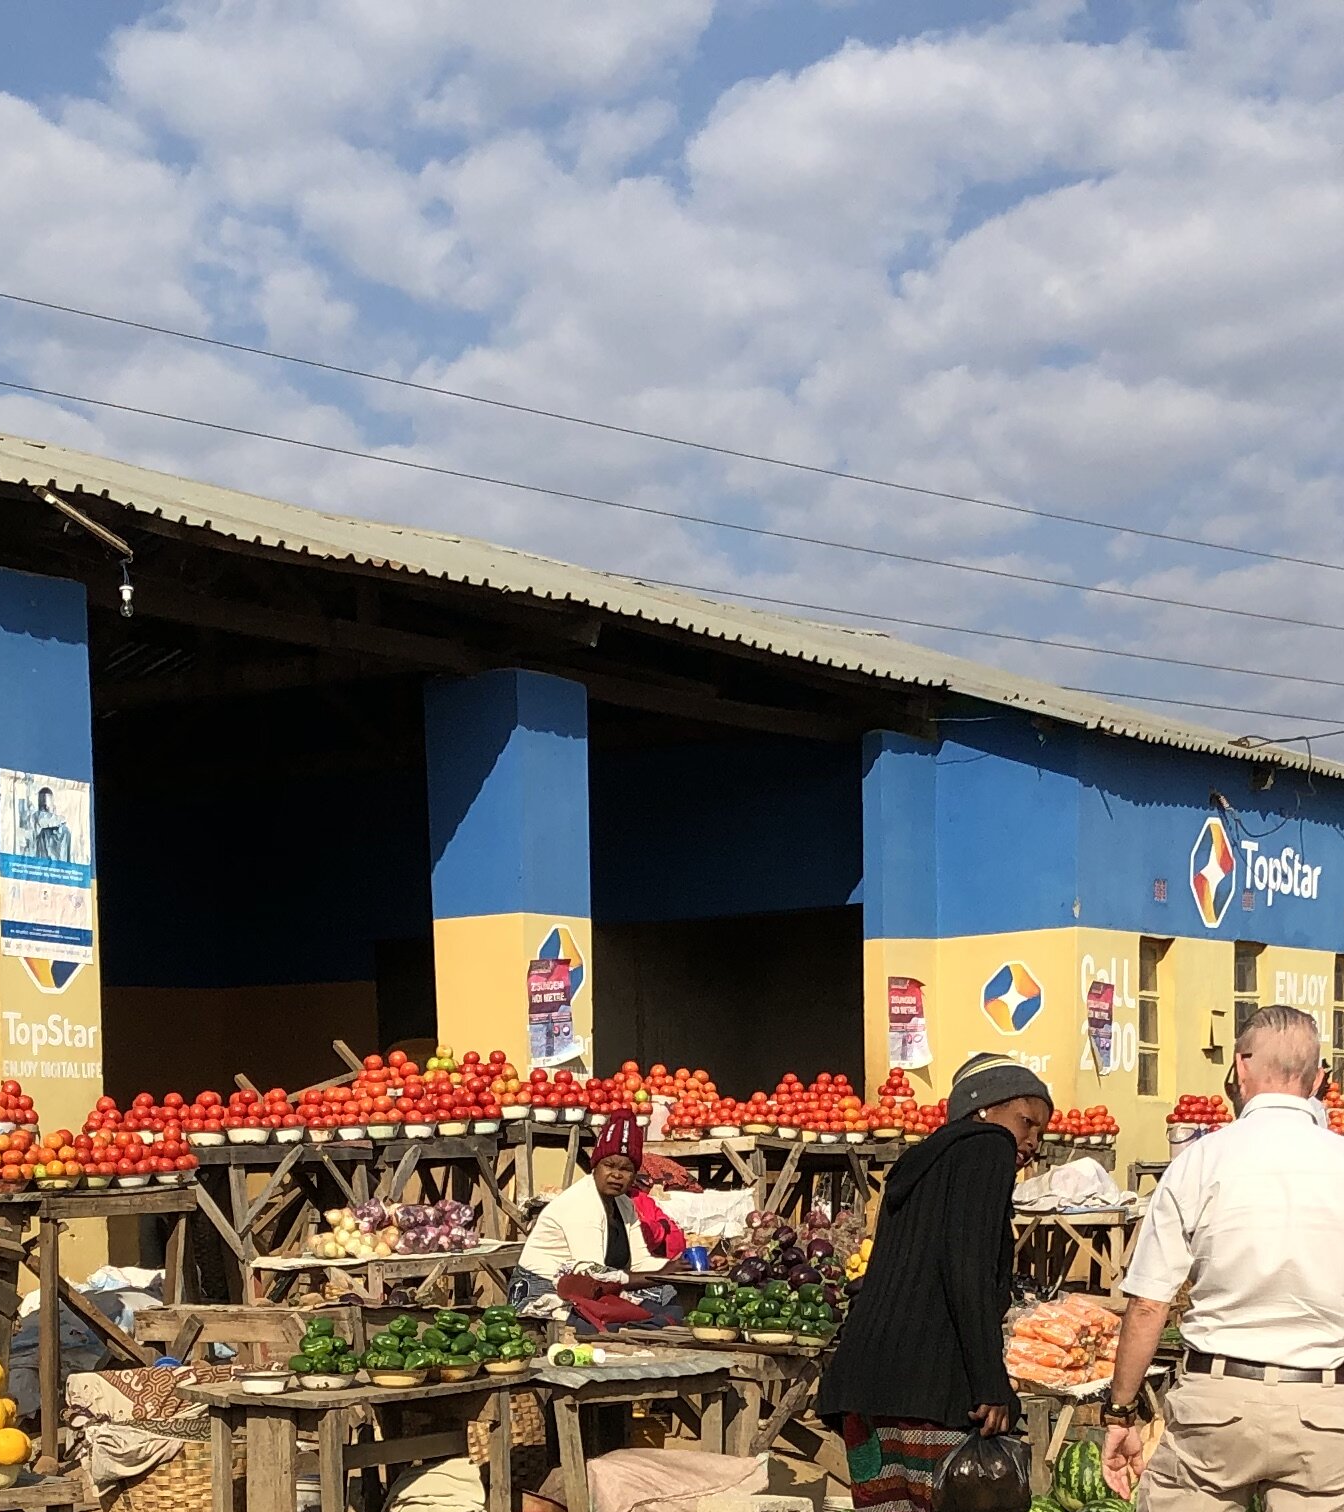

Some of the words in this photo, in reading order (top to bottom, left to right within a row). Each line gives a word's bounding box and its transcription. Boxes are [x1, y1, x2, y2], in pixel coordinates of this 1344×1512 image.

[1240, 839, 1322, 907] TopStar
[1275, 970, 1328, 1007] ENJOY
[2, 1011, 98, 1056] TopStar
[2, 1060, 38, 1078] ENJOY
[40, 1061, 81, 1079] DIGITAL
[81, 1062, 103, 1079] LIFE
